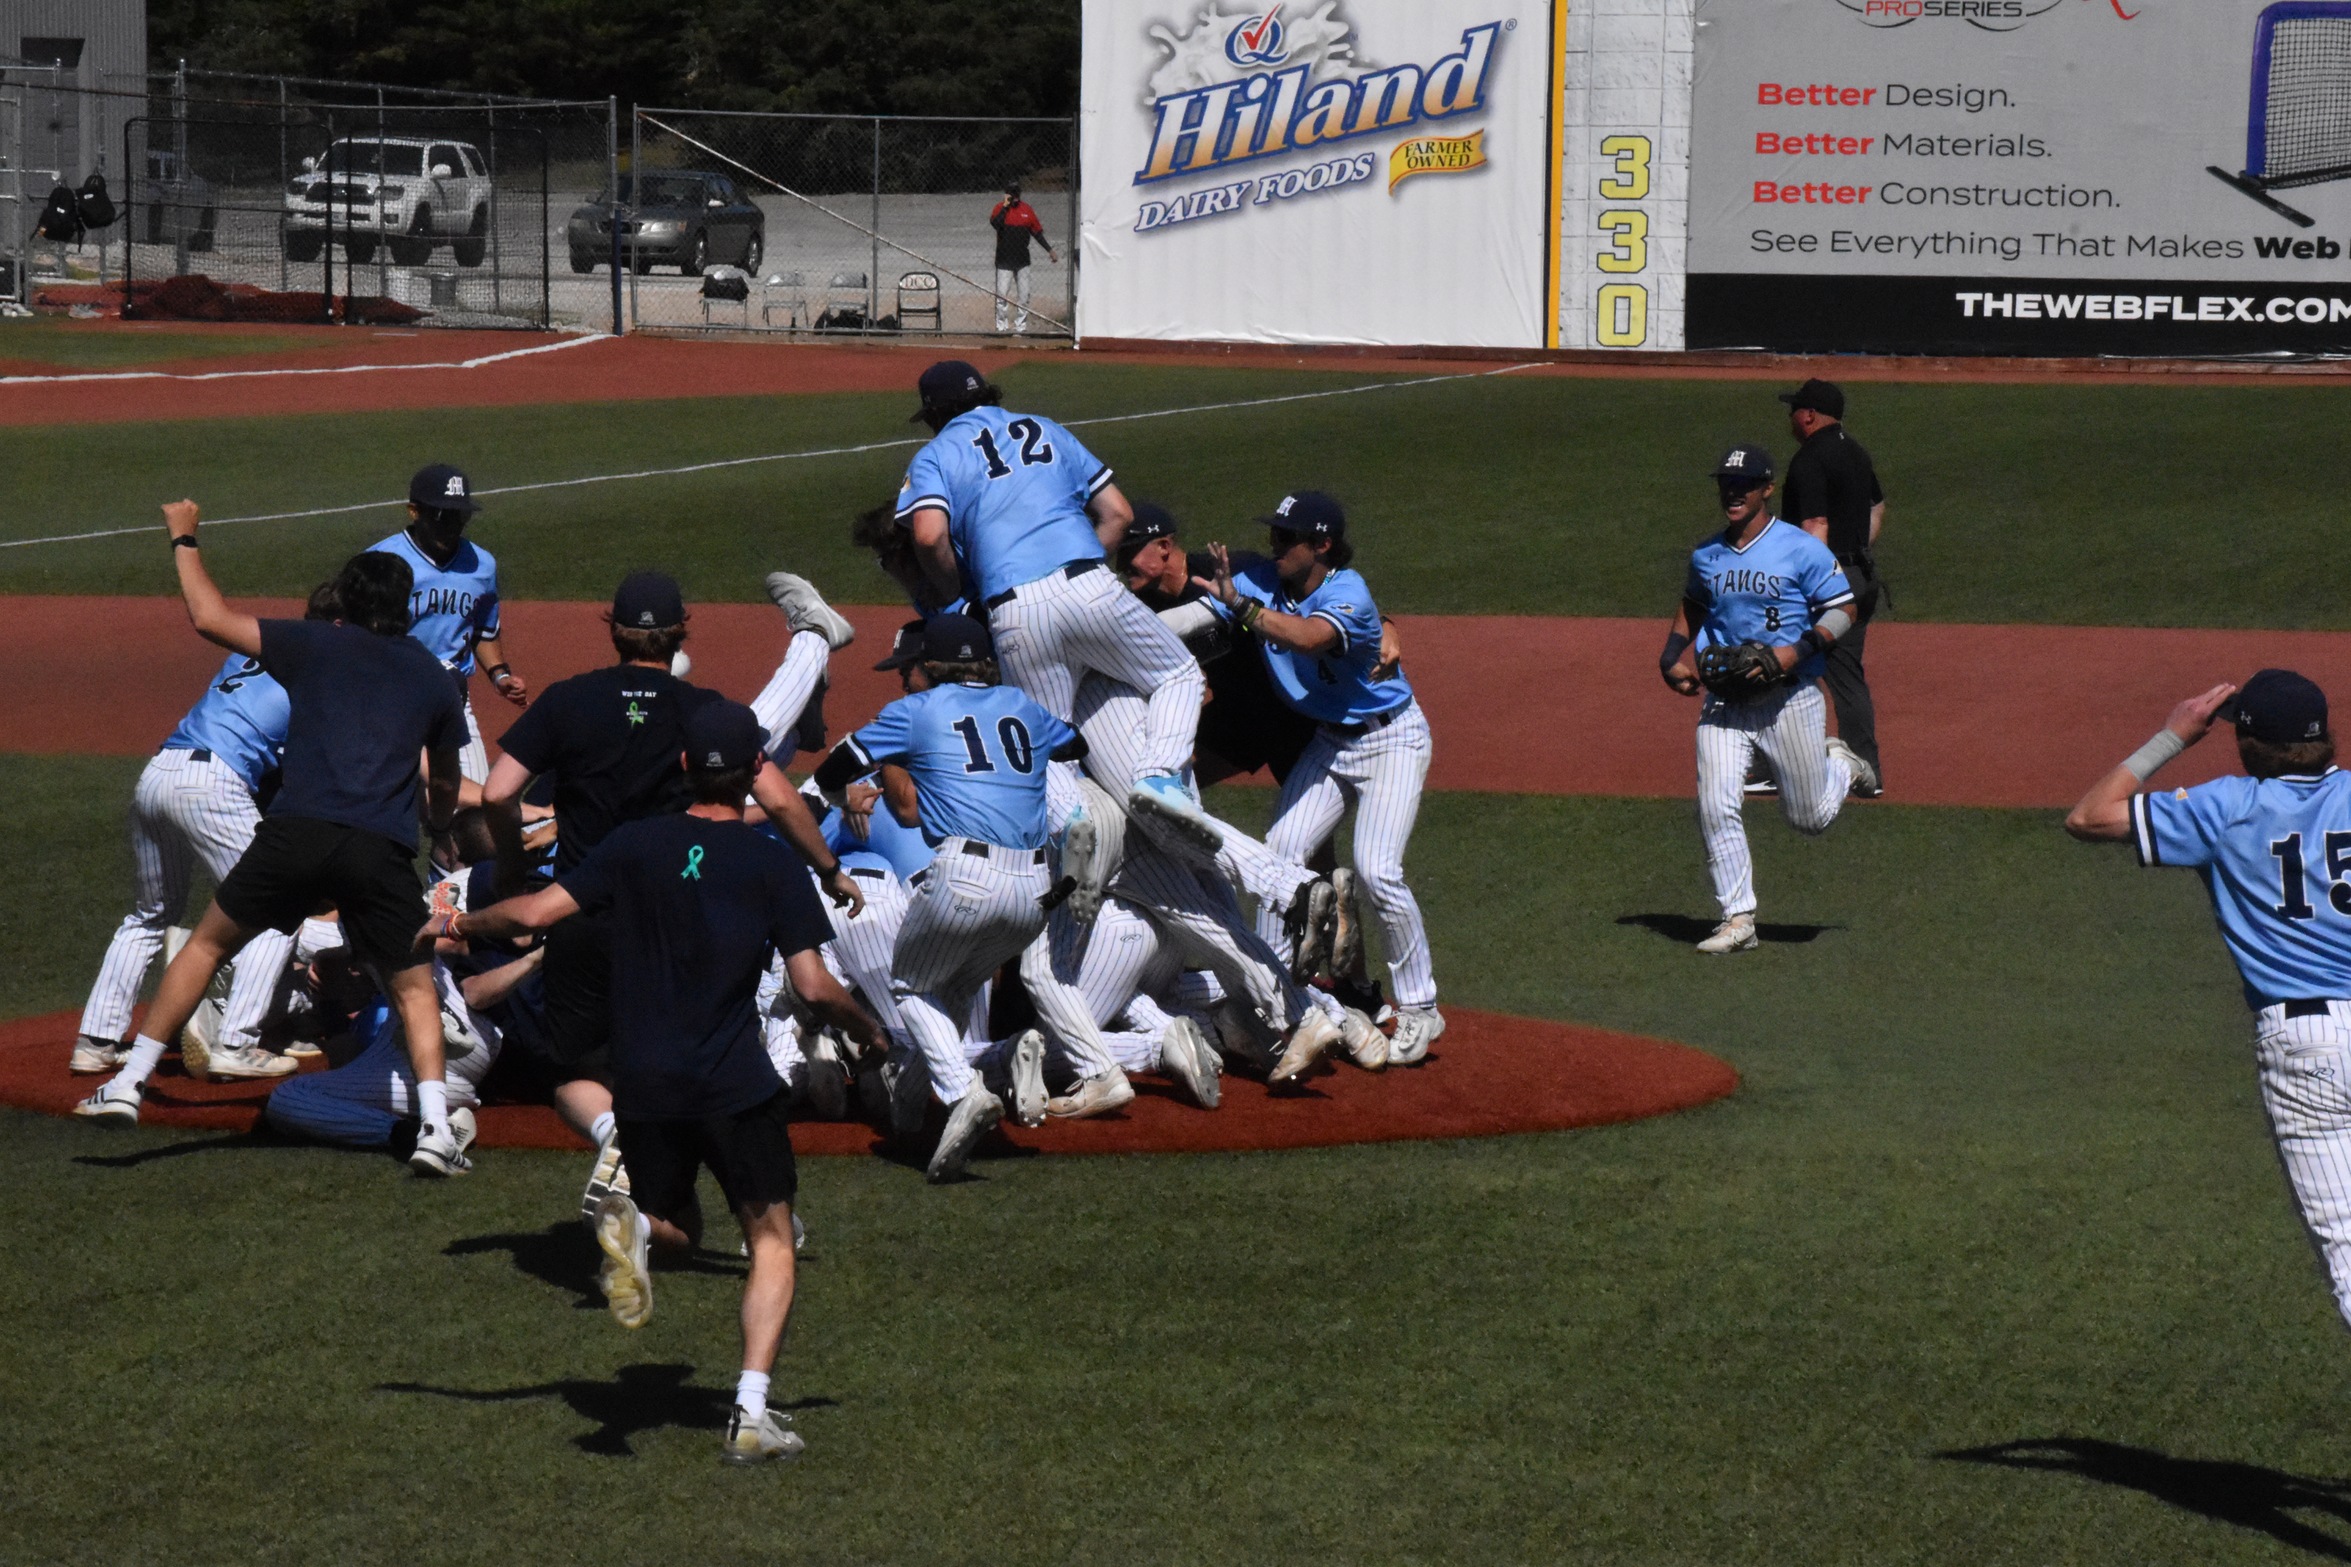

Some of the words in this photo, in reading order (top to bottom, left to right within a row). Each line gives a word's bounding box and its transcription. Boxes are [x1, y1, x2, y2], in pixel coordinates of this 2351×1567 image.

[1866, 0, 2023, 17] PROSERIES
[1132, 20, 1502, 187] Hiland
[1759, 83, 1877, 106] Better
[1886, 84, 2016, 113] Design.
[1405, 140, 1473, 158] FARMER
[1756, 132, 1875, 155] Better
[1884, 134, 2053, 157] Materials.
[1407, 153, 1470, 169] OWNED
[1134, 180, 1253, 232] DAIRY
[1253, 152, 1376, 205] FOODS
[1754, 181, 1873, 204] Better
[1880, 182, 2121, 207] Construction.
[1751, 230, 1819, 252] See
[1831, 231, 2021, 260] Everything
[2034, 233, 2115, 256] That
[2128, 235, 2245, 258] Makes
[2254, 236, 2341, 259] Web
[1957, 293, 2351, 323] THEWEBFLEX.COM
[972, 417, 1054, 480] 12
[411, 588, 482, 619] TANG
[1765, 606, 1782, 632] 8
[952, 714, 1034, 776] 10
[2269, 830, 2351, 920] 15
